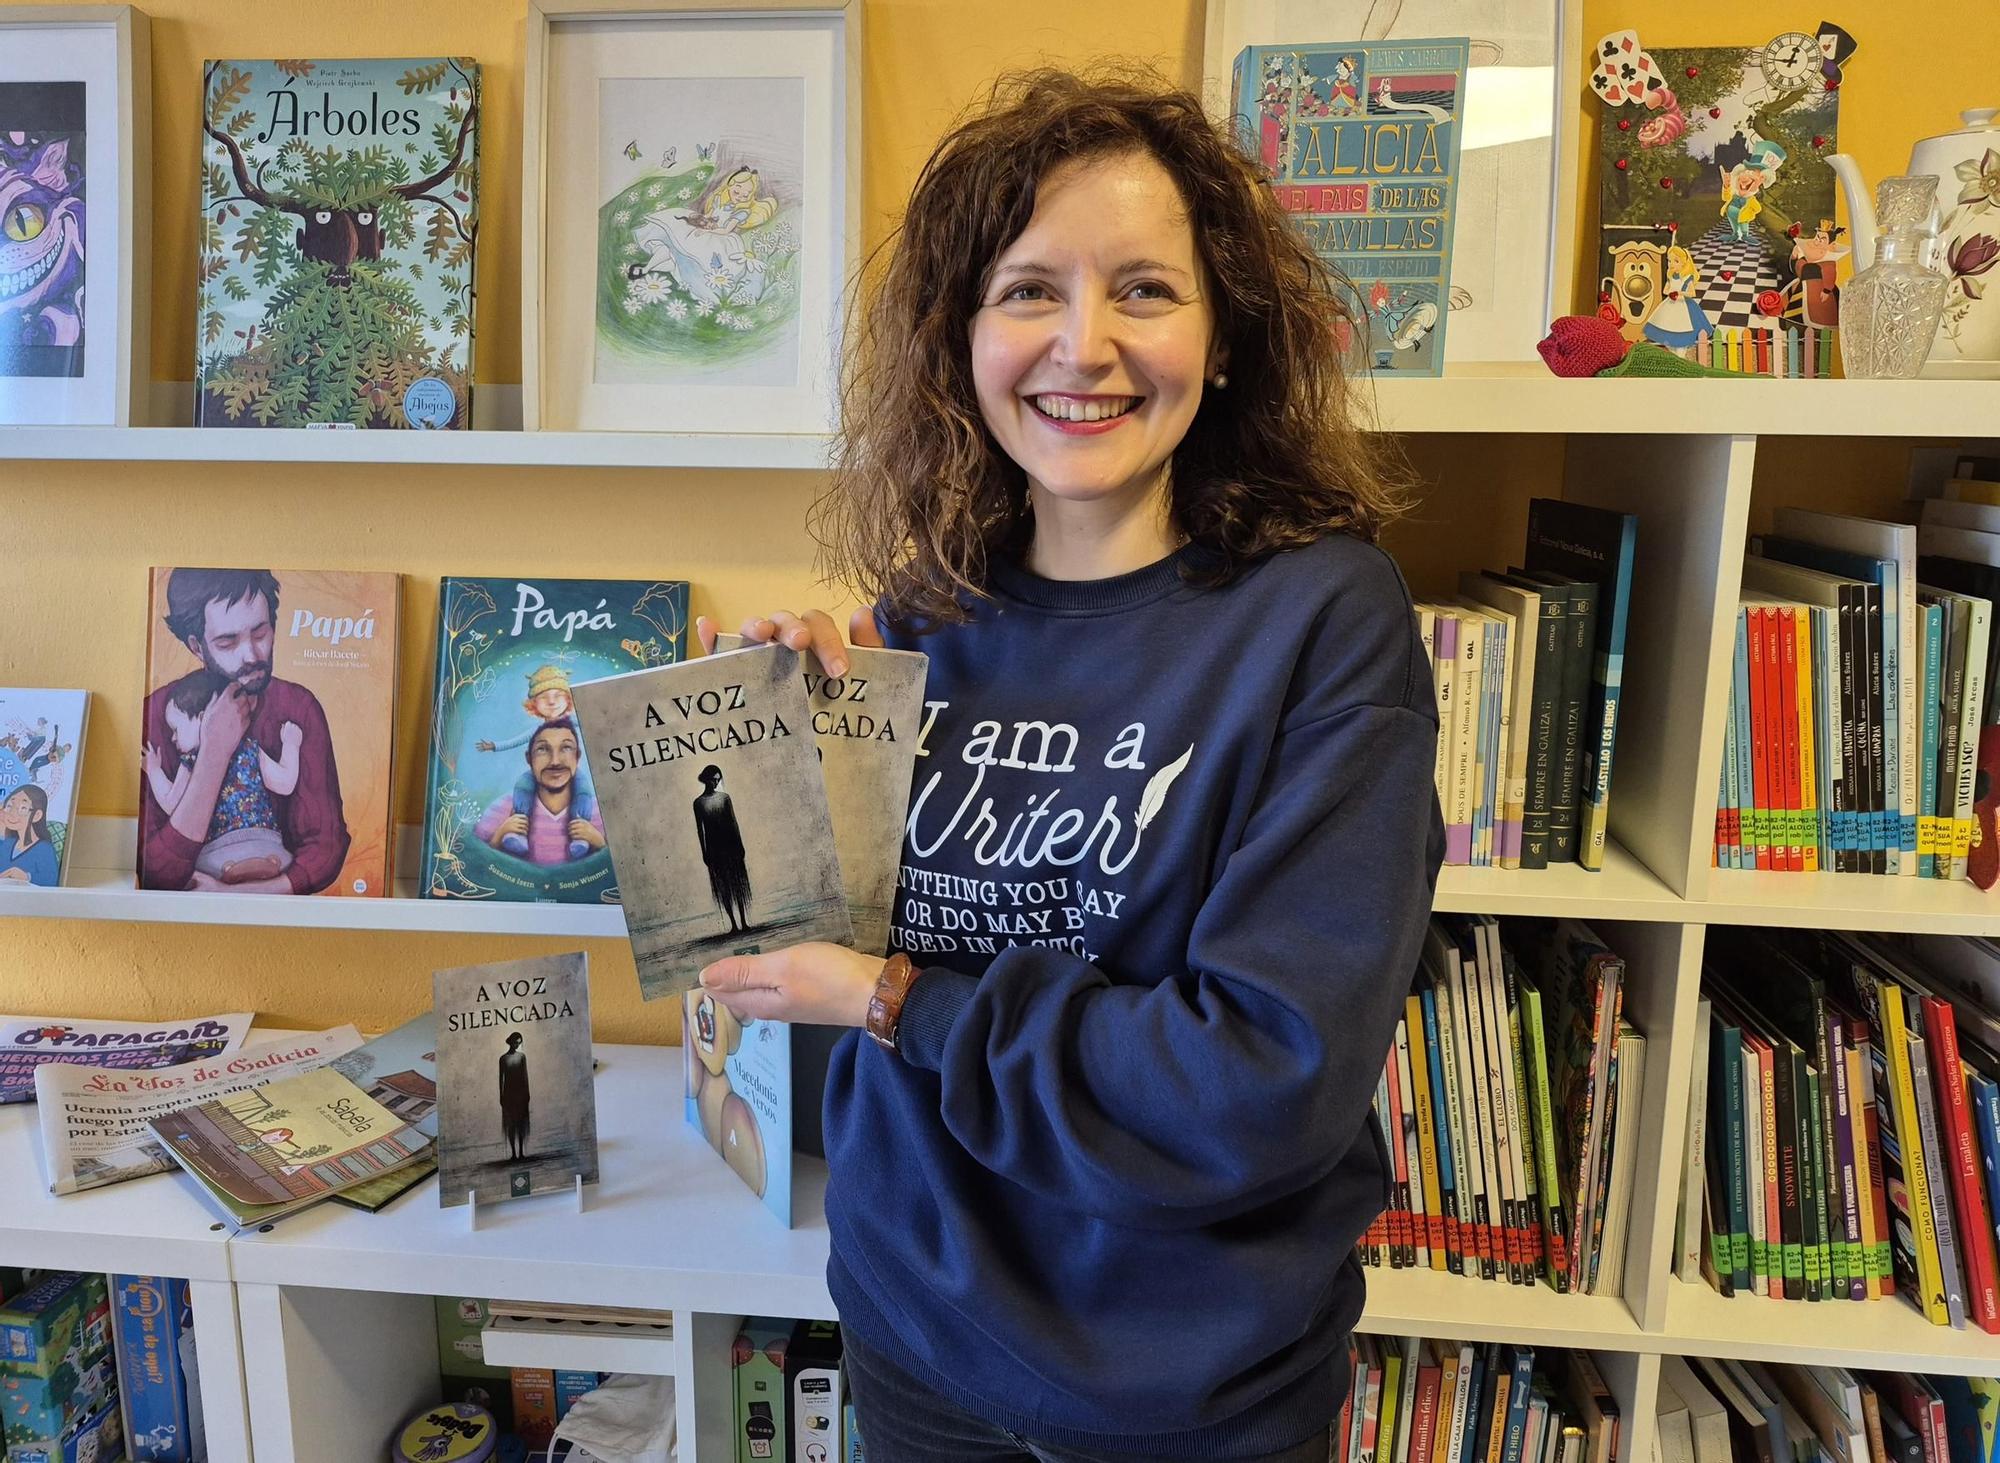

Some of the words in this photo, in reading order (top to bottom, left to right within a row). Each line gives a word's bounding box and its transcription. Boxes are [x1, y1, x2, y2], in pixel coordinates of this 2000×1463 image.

[257, 76, 420, 143] Árboles
[1298, 123, 1444, 176] ALICIA
[1291, 189, 1311, 211] EL
[1320, 185, 1364, 211] PAÍS
[1380, 188, 1402, 208] DE
[1406, 186, 1440, 207] LAS
[1378, 258, 1429, 277] ESPEJO
[409, 397, 449, 415] Abejas
[510, 582, 617, 643] Papá
[289, 608, 375, 645] Papá
[1466, 641, 1474, 661] GAL
[1843, 652, 1851, 674] Suárez
[1871, 652, 1879, 674] Suárez
[803, 673, 868, 703] VOZ
[1442, 682, 1450, 701] GAL
[1953, 670, 1961, 693] SUÁREZ
[1970, 677, 1978, 702] Arcas
[645, 702, 665, 729] A
[672, 684, 746, 721] VOZ
[1967, 707, 1976, 727] José
[1462, 706, 1471, 735] Alfonso
[1538, 713, 1550, 750] GALIZA
[1567, 709, 1578, 745] GALIZA
[1601, 728, 1613, 740] OS
[915, 701, 949, 757] I
[962, 720, 1079, 773] am
[1104, 721, 1146, 771] a
[1844, 720, 1853, 756] BIBLIOTECA
[1857, 721, 1867, 749] COCIÑA
[1871, 725, 1881, 756] COMPRAS
[1947, 725, 1957, 747] PINDO
[1537, 753, 1547, 767] EN
[1565, 748, 1575, 762] EN
[1946, 750, 1955, 773] MONTE
[1960, 742, 1974, 765] ISO?
[1459, 751, 1468, 786] SEMPRE
[1597, 750, 1611, 791] CASTELAO
[1458, 788, 1466, 799] DE
[1534, 771, 1546, 809] SEMPRE
[1561, 765, 1574, 804] SEMPRE
[1958, 769, 1972, 806] VICHES
[1457, 800, 1465, 824] DOUS
[1595, 832, 1604, 846] GAL
[488, 863, 516, 884] Susanna
[559, 880, 579, 890] Sonja
[580, 867, 609, 885] Wimmer
[896, 865, 998, 906] NYTHING
[1002, 877, 1068, 906] YOU
[906, 898, 934, 928] OR
[939, 906, 977, 932] DO
[983, 910, 1052, 934] MAY
[1062, 906, 1086, 930] B
[890, 925, 957, 953] USED
[962, 936, 997, 955] IN
[476, 984, 490, 1002] A
[497, 977, 547, 998] VOZ
[1508, 973, 1516, 1004] GERSTEIN
[53, 1021, 229, 1047] PAPAGAIO
[107, 1050, 149, 1061] DOS
[1944, 1026, 1960, 1087] Naylor-Ballesteros
[83, 1074, 128, 1094] La
[129, 1075, 184, 1092] Voz
[193, 1063, 219, 1082] de
[227, 1045, 319, 1074] Galicia
[734, 1058, 778, 1106] Macedonia
[1915, 1067, 1927, 1077] 23
[64, 1103, 136, 1115] Ucrania
[137, 1097, 192, 1115] acepta
[197, 1090, 219, 1100] un
[223, 1083, 253, 1096] alto
[255, 1079, 271, 1089] el
[752, 1089, 777, 1124] Versos
[1494, 1088, 1503, 1116] GLOBO
[1507, 1088, 1515, 1115] AMIGOS
[1952, 1087, 1962, 1105] Chris
[67, 1114, 115, 1128] fuego
[327, 1098, 375, 1132] Sabela
[1497, 1118, 1504, 1127] EL
[69, 1127, 98, 1140] por
[1424, 1147, 1434, 1175] CIRCO
[1960, 1132, 1972, 1163] maleta
[1784, 1145, 1795, 1208] SNOWHITE
[1915, 1150, 1929, 1206] FUNCIONA?
[1964, 1166, 1974, 1176] La
[1922, 1210, 1932, 1241] COMO
[140, 1291, 150, 1312] non
[143, 1315, 153, 1331] es
[144, 1336, 156, 1348] de
[1420, 1385, 1433, 1413] felices
[1456, 1380, 1467, 1423] MARAVILLOSA
[1416, 1414, 1430, 1451] familias
[1454, 1425, 1462, 1441] CAJA
[1468, 1415, 1476, 1430] Pablo
[1510, 1425, 1520, 1448] HIELO
[1451, 1452, 1458, 1460] EN
[1508, 1449, 1516, 1461] DE
